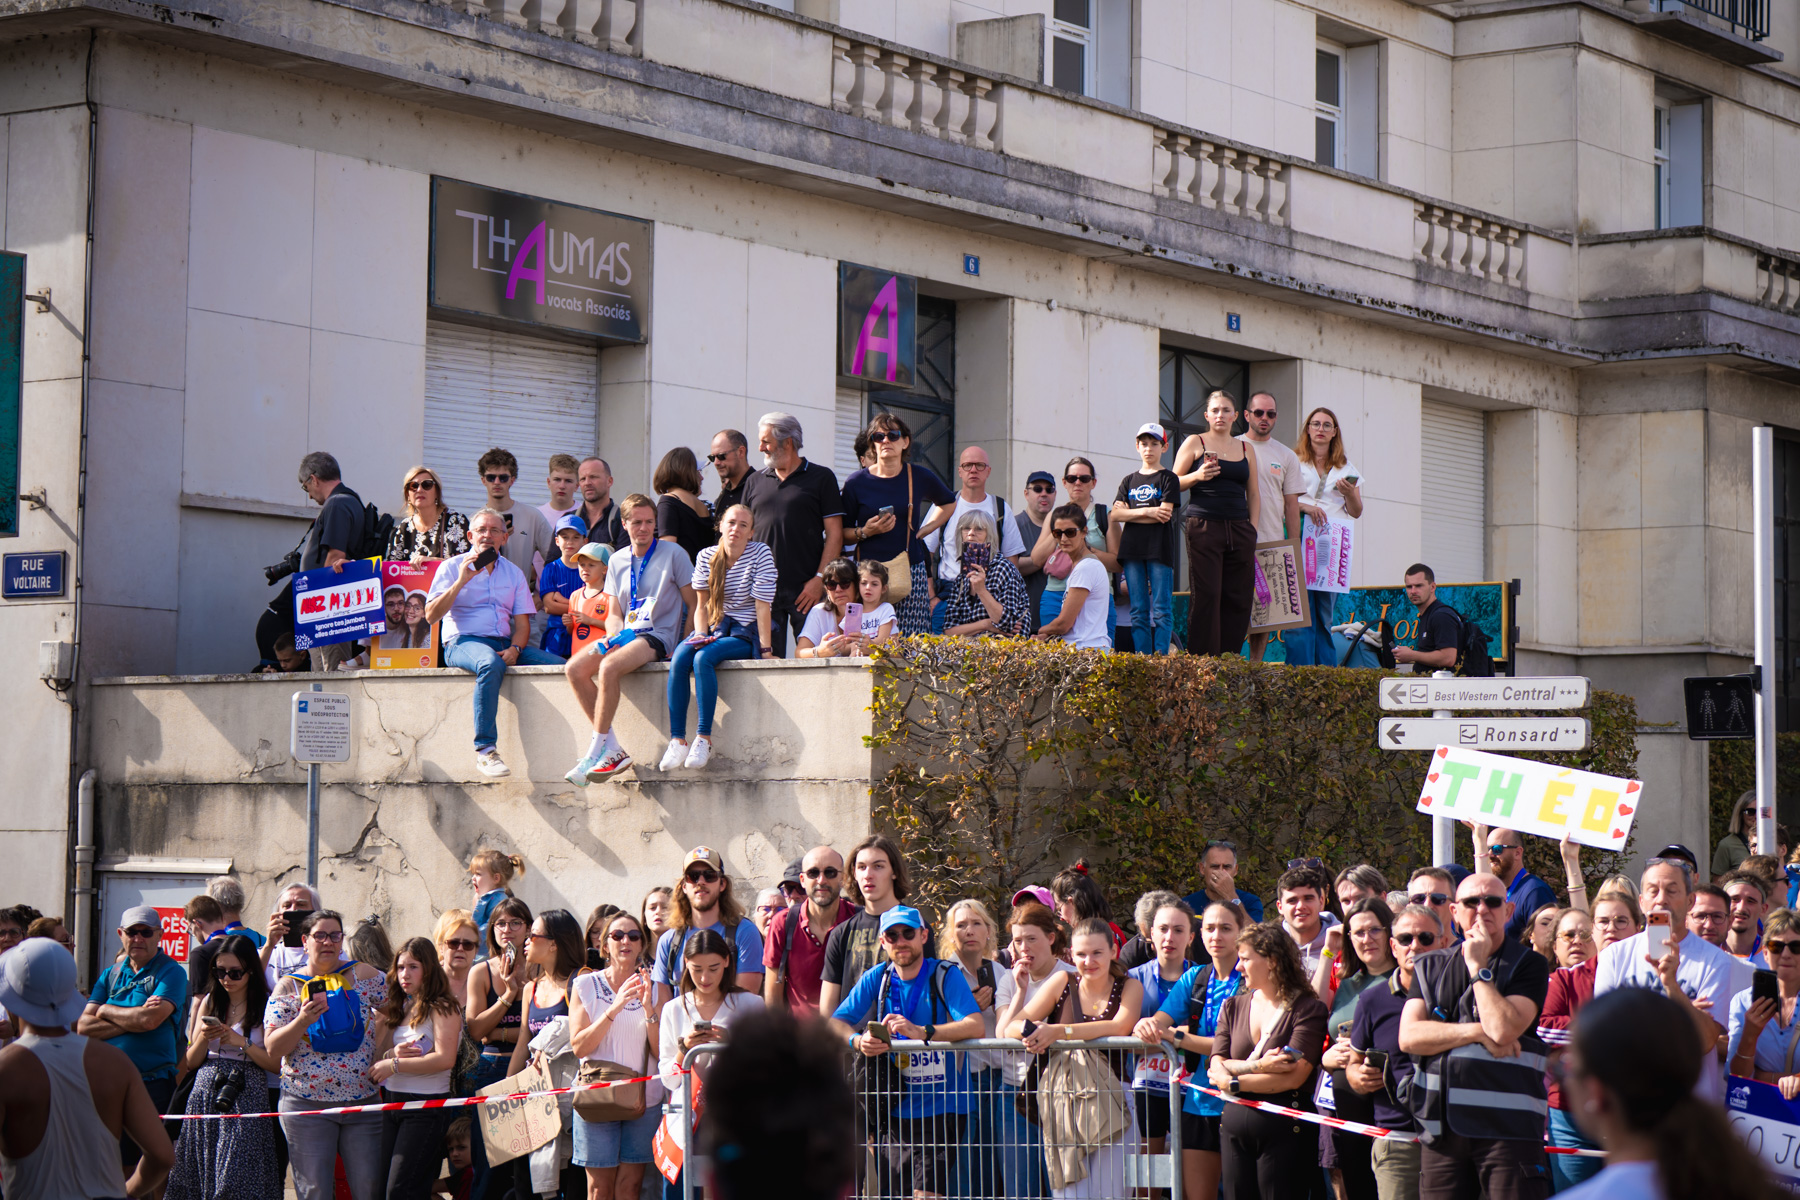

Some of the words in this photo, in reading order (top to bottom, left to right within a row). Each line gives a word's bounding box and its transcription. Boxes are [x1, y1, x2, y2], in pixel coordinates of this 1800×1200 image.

[455, 209, 632, 305] THAUMAS
[969, 257, 975, 272] 6
[585, 298, 631, 321] Associés
[851, 275, 898, 382] A
[1231, 315, 1237, 329] 5
[22, 559, 44, 571] RUE
[13, 576, 51, 589] VOLTAIRE
[1434, 691, 1456, 701] Best
[1459, 691, 1498, 701] Western
[1502, 686, 1556, 701] Central
[1484, 727, 1559, 742] Ronsard
[1441, 760, 1620, 834] THÉO
[160, 912, 188, 934] CÈS
